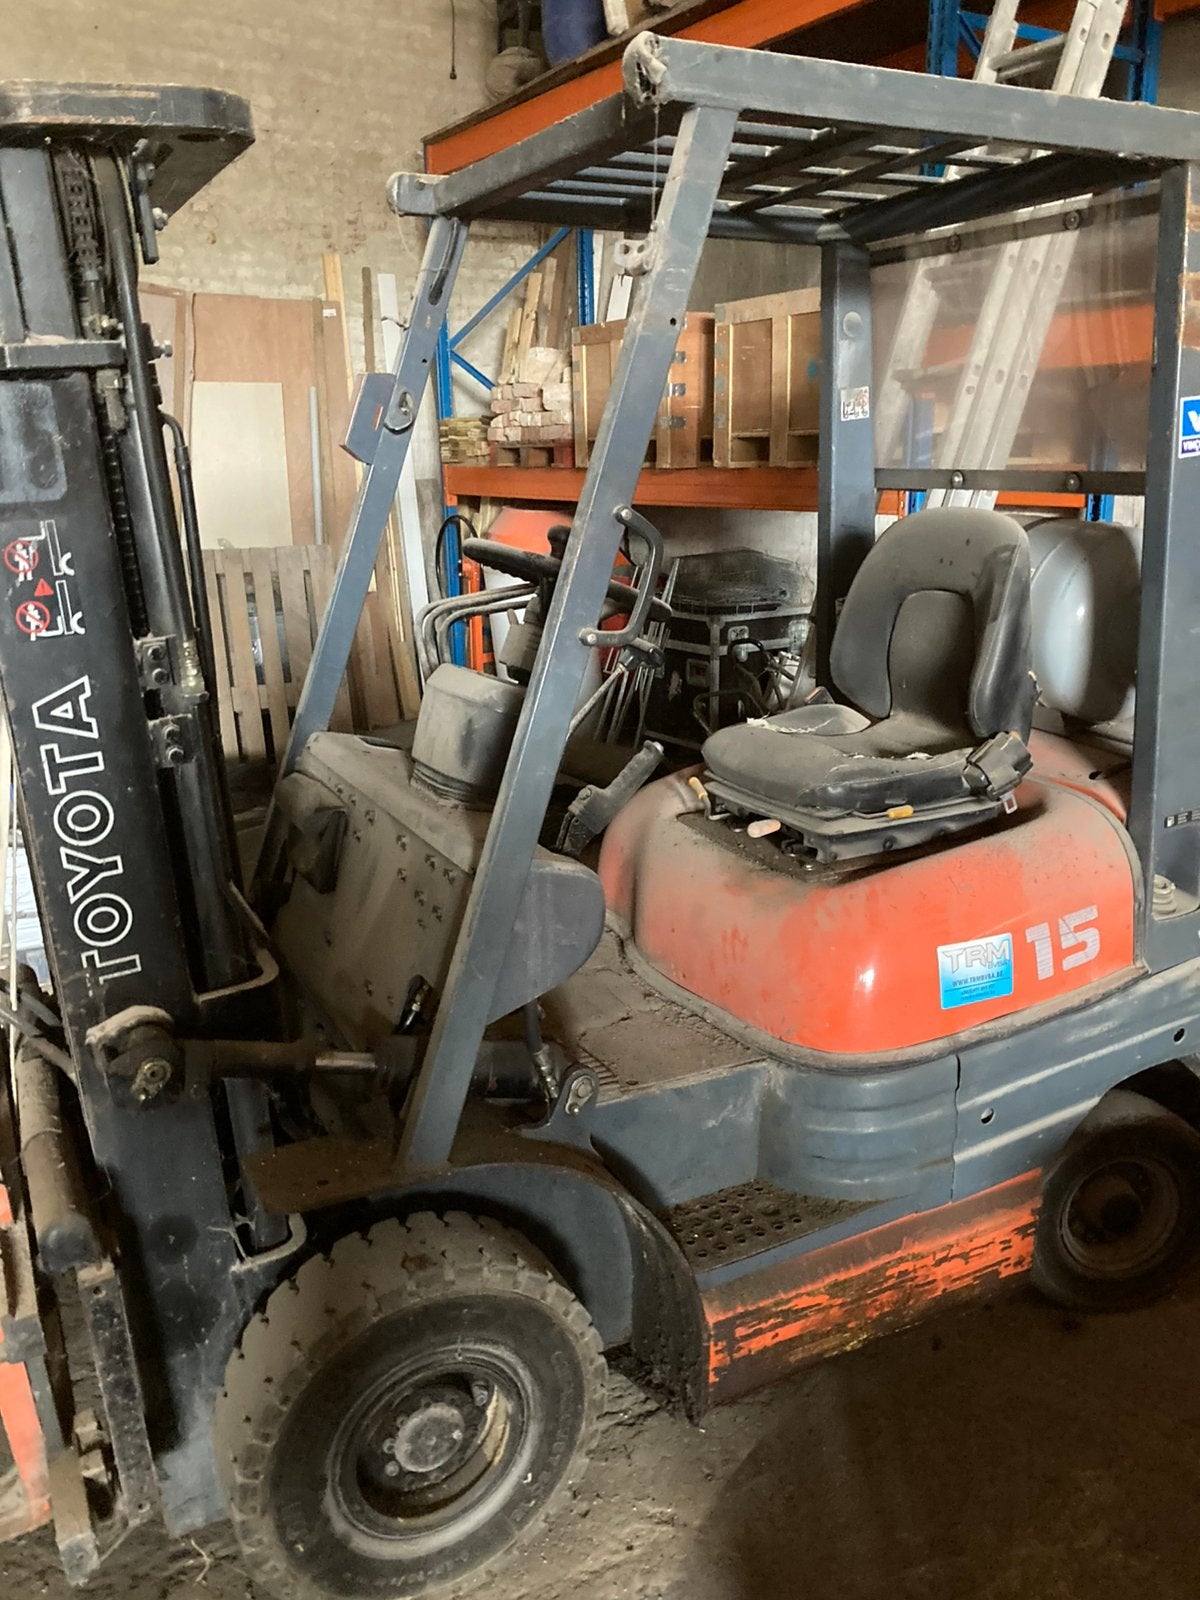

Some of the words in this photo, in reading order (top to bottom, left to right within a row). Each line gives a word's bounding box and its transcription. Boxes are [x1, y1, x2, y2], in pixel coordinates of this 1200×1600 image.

[32, 675, 142, 985] TOYOTA
[942, 939, 1011, 974] TRM
[1026, 905, 1100, 980] 15
